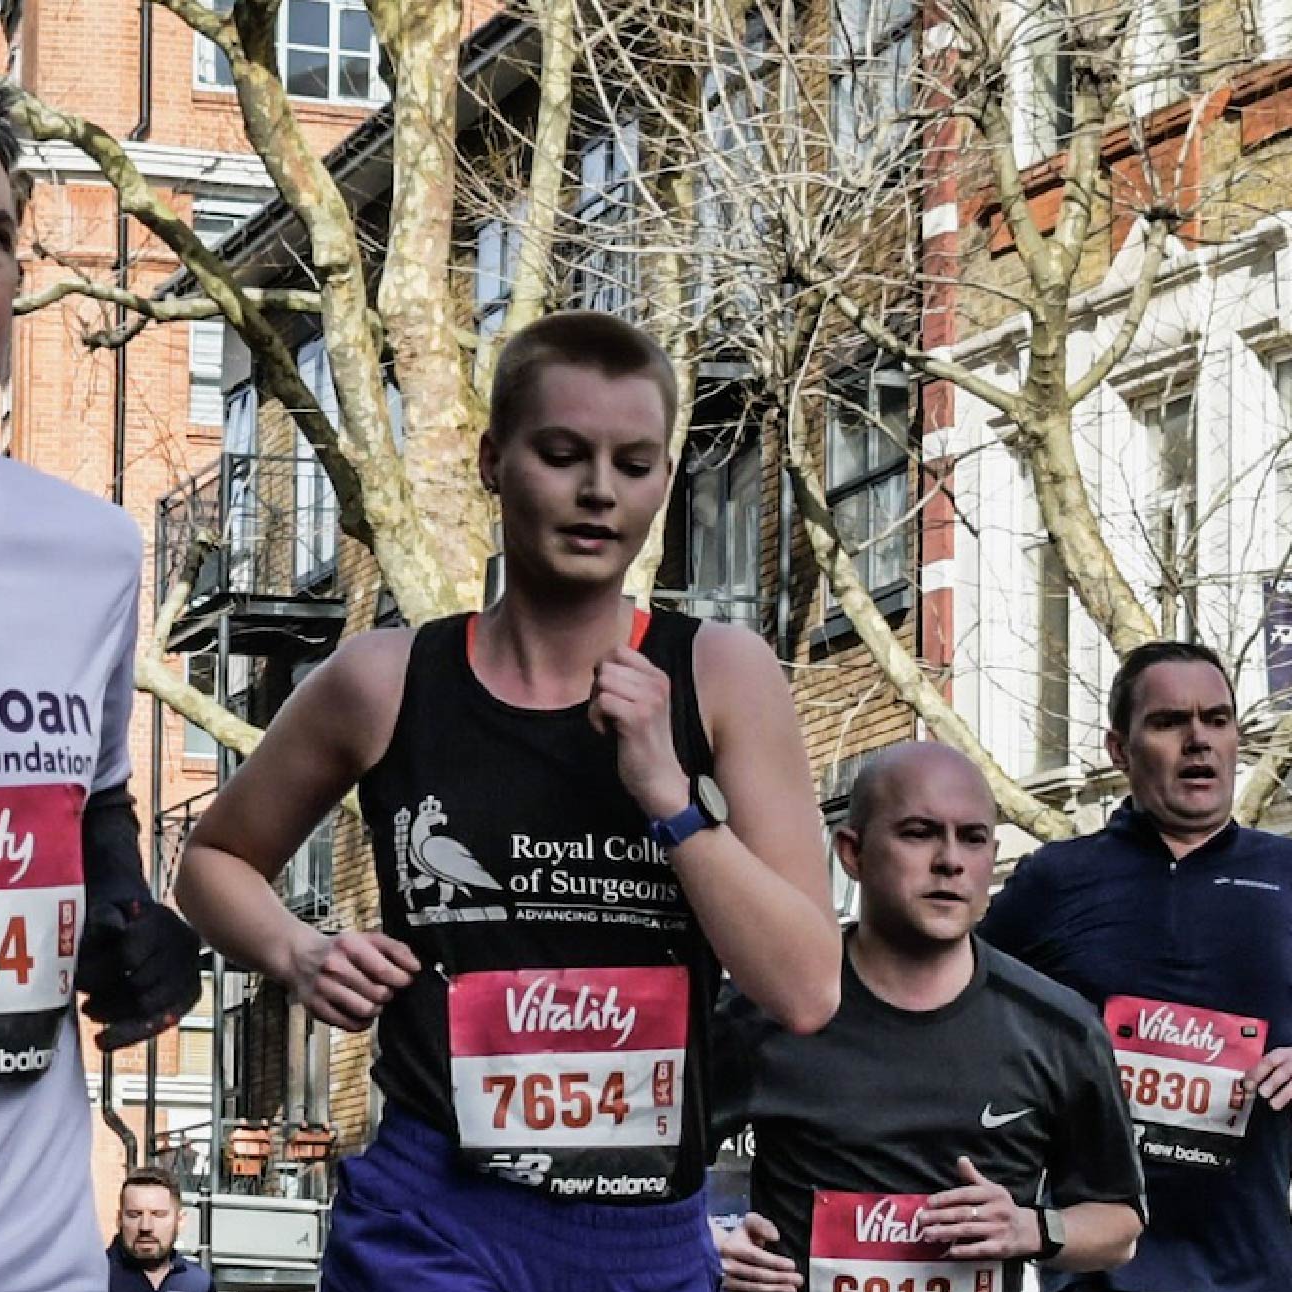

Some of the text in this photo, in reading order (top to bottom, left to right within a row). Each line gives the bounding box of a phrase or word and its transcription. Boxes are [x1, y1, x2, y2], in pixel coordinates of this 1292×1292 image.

[510, 833, 670, 866] Royal Colle
[509, 868, 679, 904] of Surgeons
[601, 911, 661, 930] SURGICA
[506, 976, 637, 1048] Vitality
[1137, 1004, 1227, 1063] Vitality
[481, 1070, 630, 1131] 7654
[1116, 1065, 1212, 1115] 6830
[656, 1115, 668, 1136] 5
[550, 1175, 595, 1194] new
[855, 1197, 926, 1244] Vital
